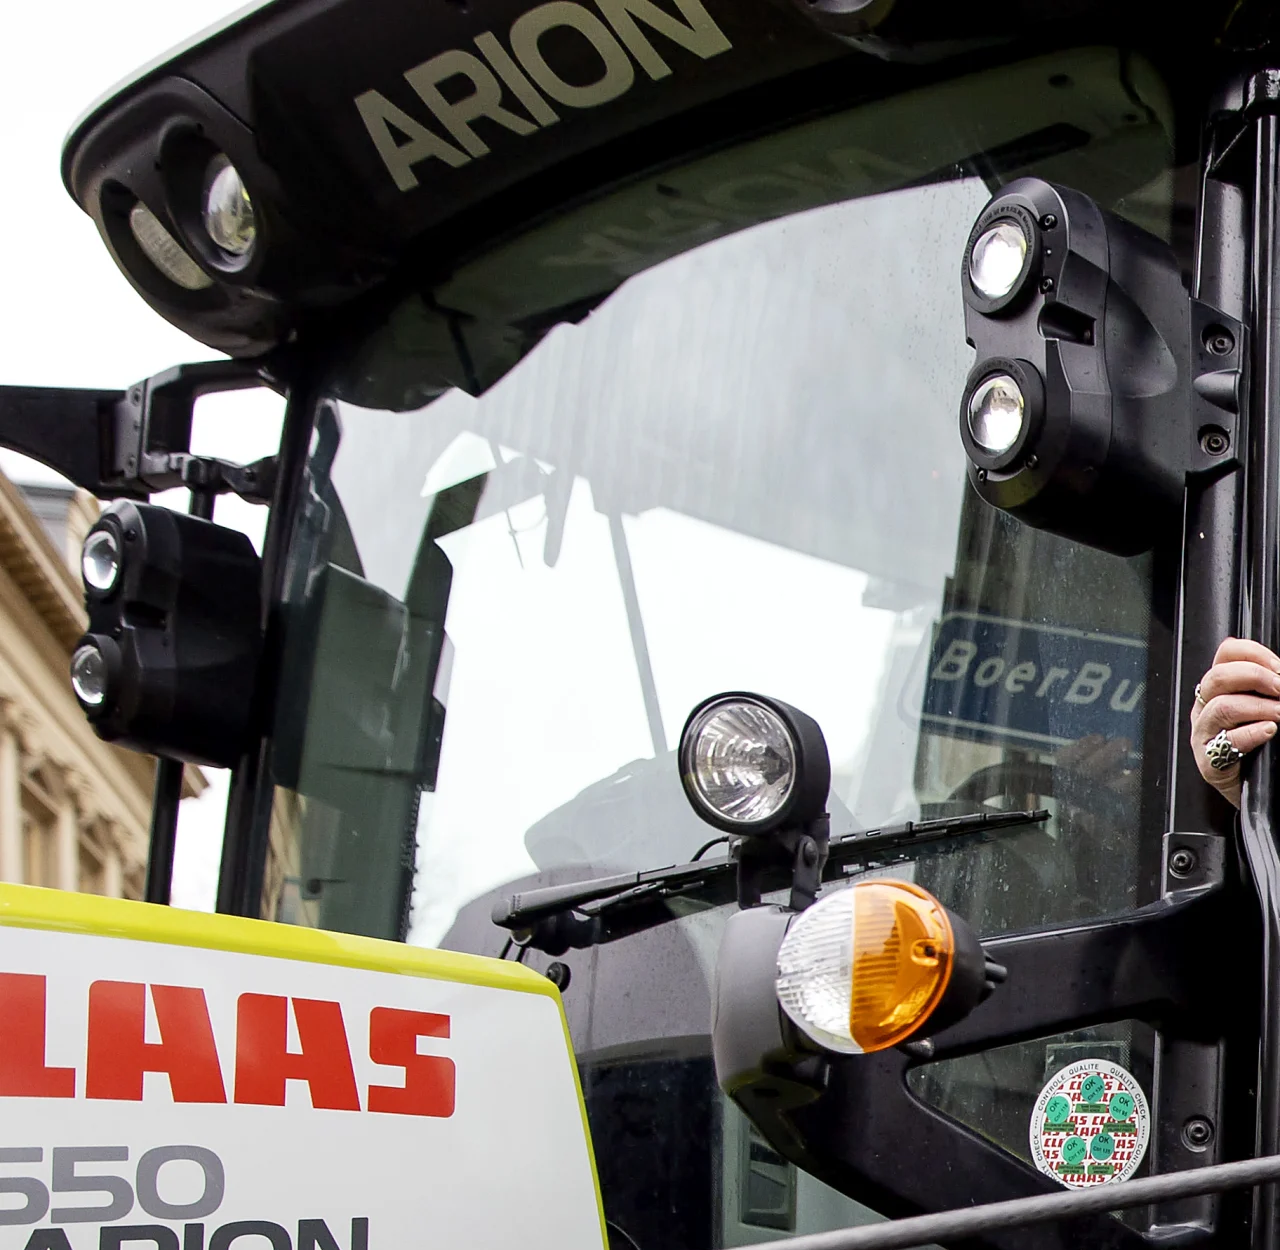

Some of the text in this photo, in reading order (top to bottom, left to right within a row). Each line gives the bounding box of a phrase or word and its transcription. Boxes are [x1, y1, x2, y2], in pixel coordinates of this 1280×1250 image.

[354, 0, 733, 192] ARION
[931, 638, 1147, 713] BoerBu
[1038, 1063, 1099, 1111] CONTROLE QUALITE
[1085, 1079, 1096, 1091] OK
[1110, 1067, 1147, 1121] QUALITY CHECK
[1049, 1100, 1060, 1112] OK
[1119, 1096, 1130, 1107] OK
[1033, 1134, 1043, 1161] CHECK
[1067, 1140, 1078, 1151] OK
[1098, 1136, 1110, 1144] OK
[1118, 1144, 1144, 1181] CONTROLE
[0, 1145, 225, 1226] 550
[1063, 1174, 1105, 1183] CLAAS
